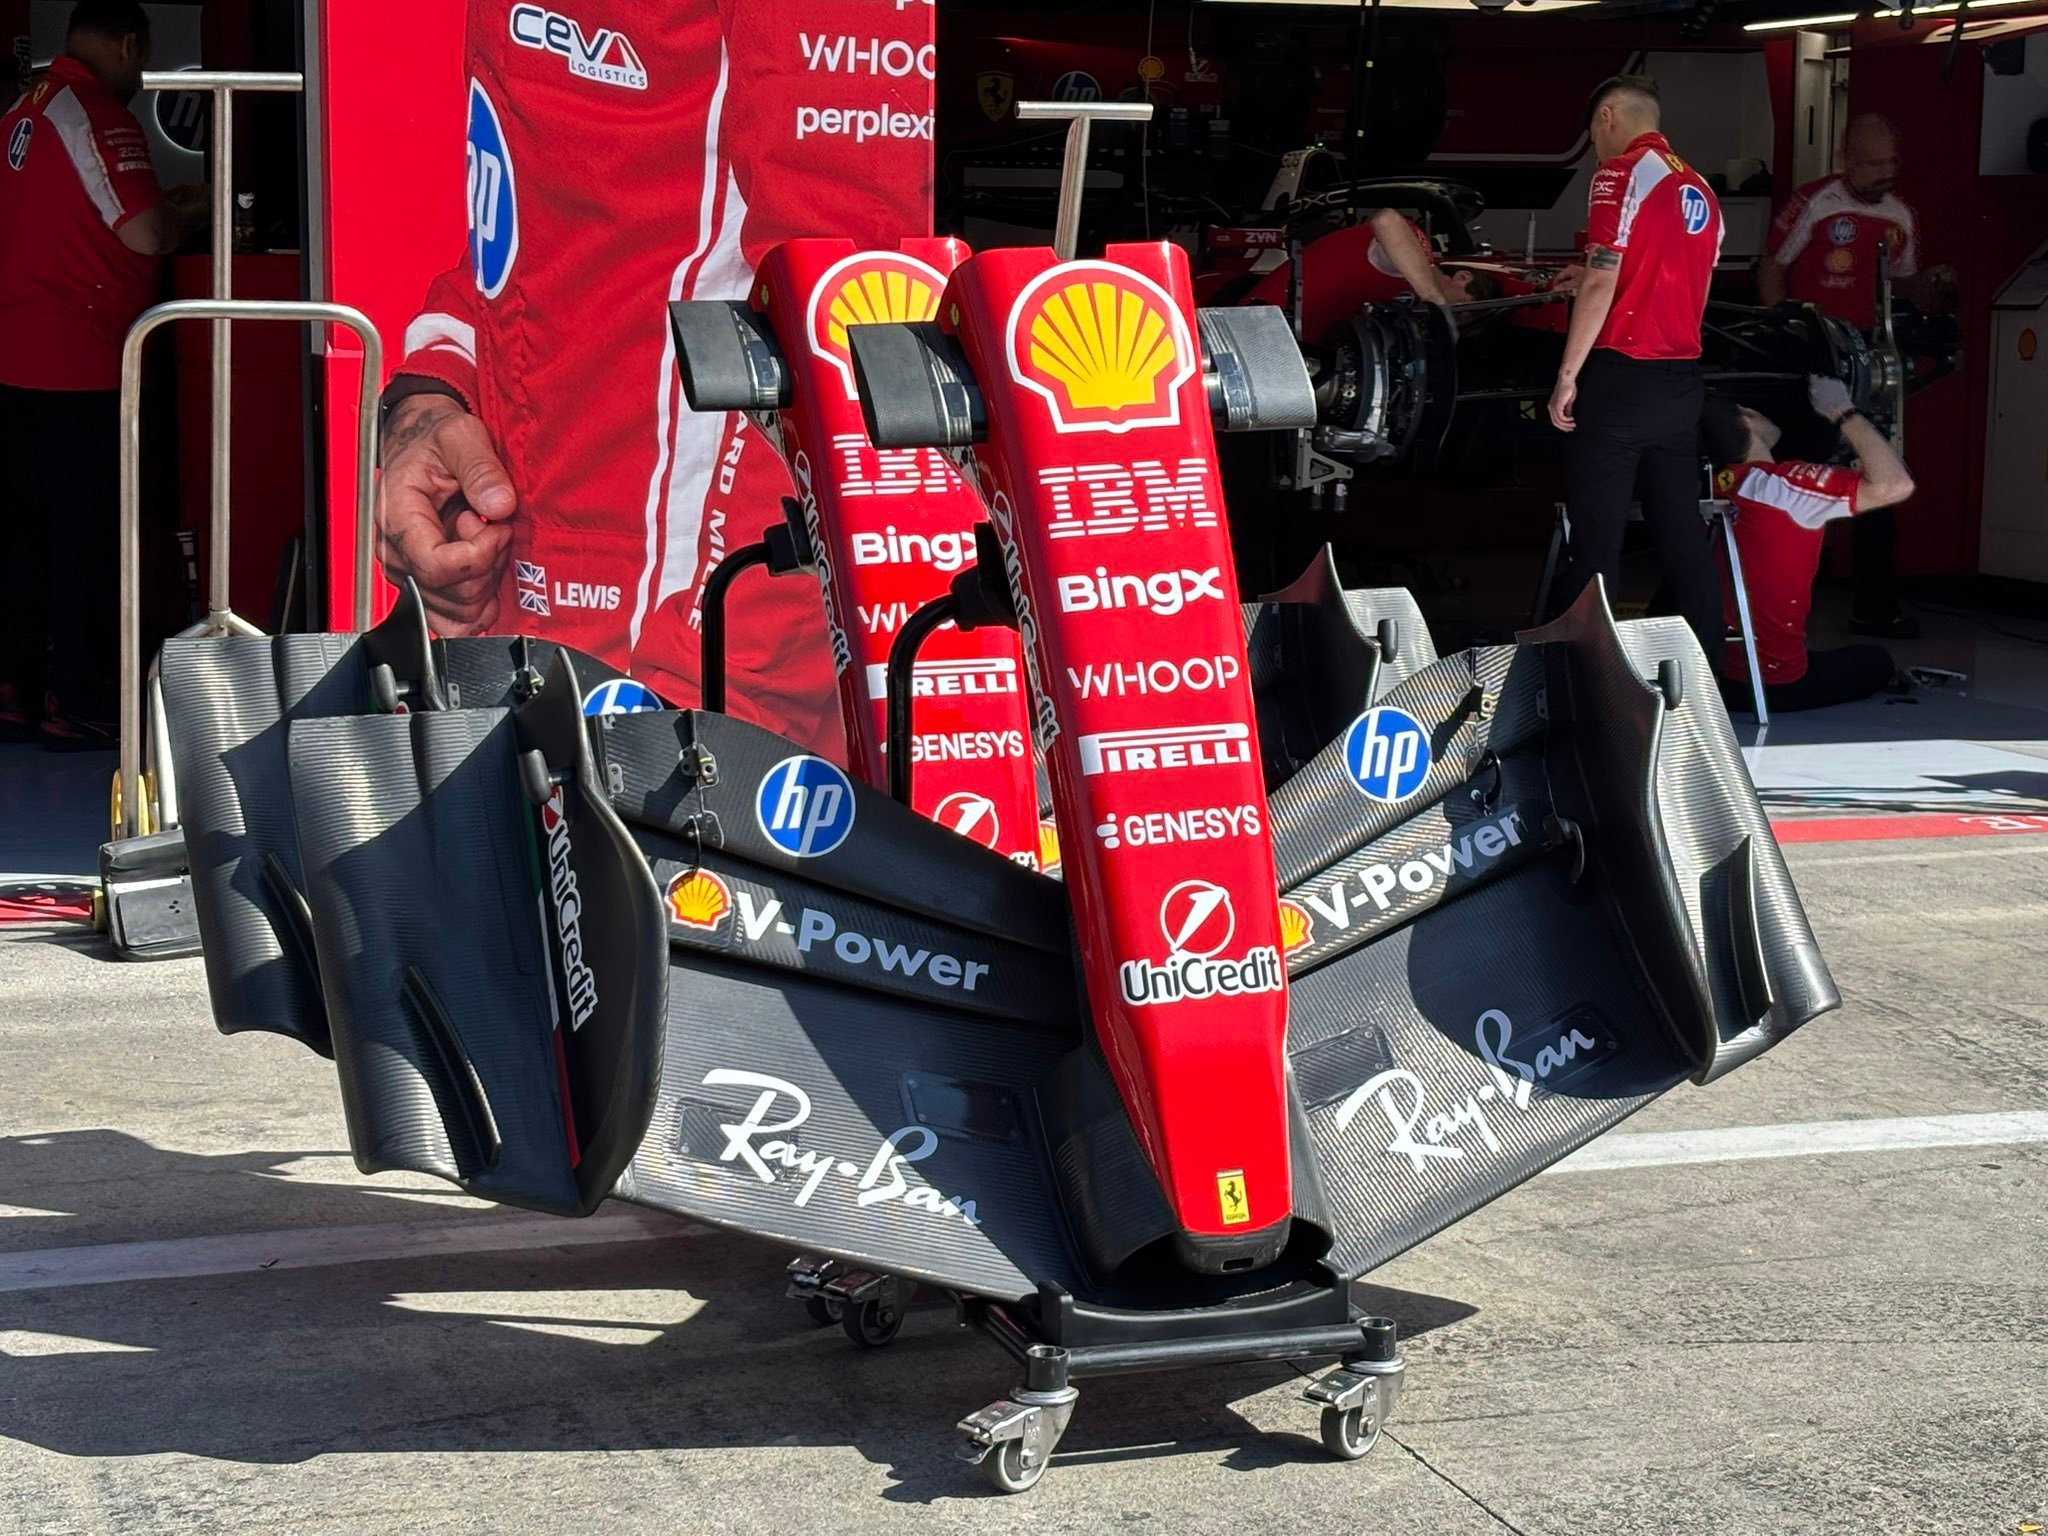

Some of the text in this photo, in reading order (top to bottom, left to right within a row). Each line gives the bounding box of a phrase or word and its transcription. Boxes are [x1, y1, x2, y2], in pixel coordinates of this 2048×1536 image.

[571, 61, 646, 87] LOGISTICS
[799, 33, 935, 80] WHOO
[797, 103, 935, 143] perplexi
[1681, 186, 1705, 233] hp
[1243, 231, 1277, 243] ZYN
[1039, 458, 1217, 539] IBM
[554, 581, 622, 611] LEWIS
[866, 657, 1017, 700] PRELLI
[1067, 655, 1240, 699] WHOOP
[1078, 723, 1250, 775] PIRELLI
[1358, 707, 1420, 803] hp
[768, 756, 843, 857] hp
[1124, 804, 1261, 847] GENESYS
[1307, 808, 1527, 933] V-Power
[547, 819, 600, 1032] UniCredit
[736, 889, 990, 991] V-Power
[1121, 946, 1282, 1005] UniCredit
